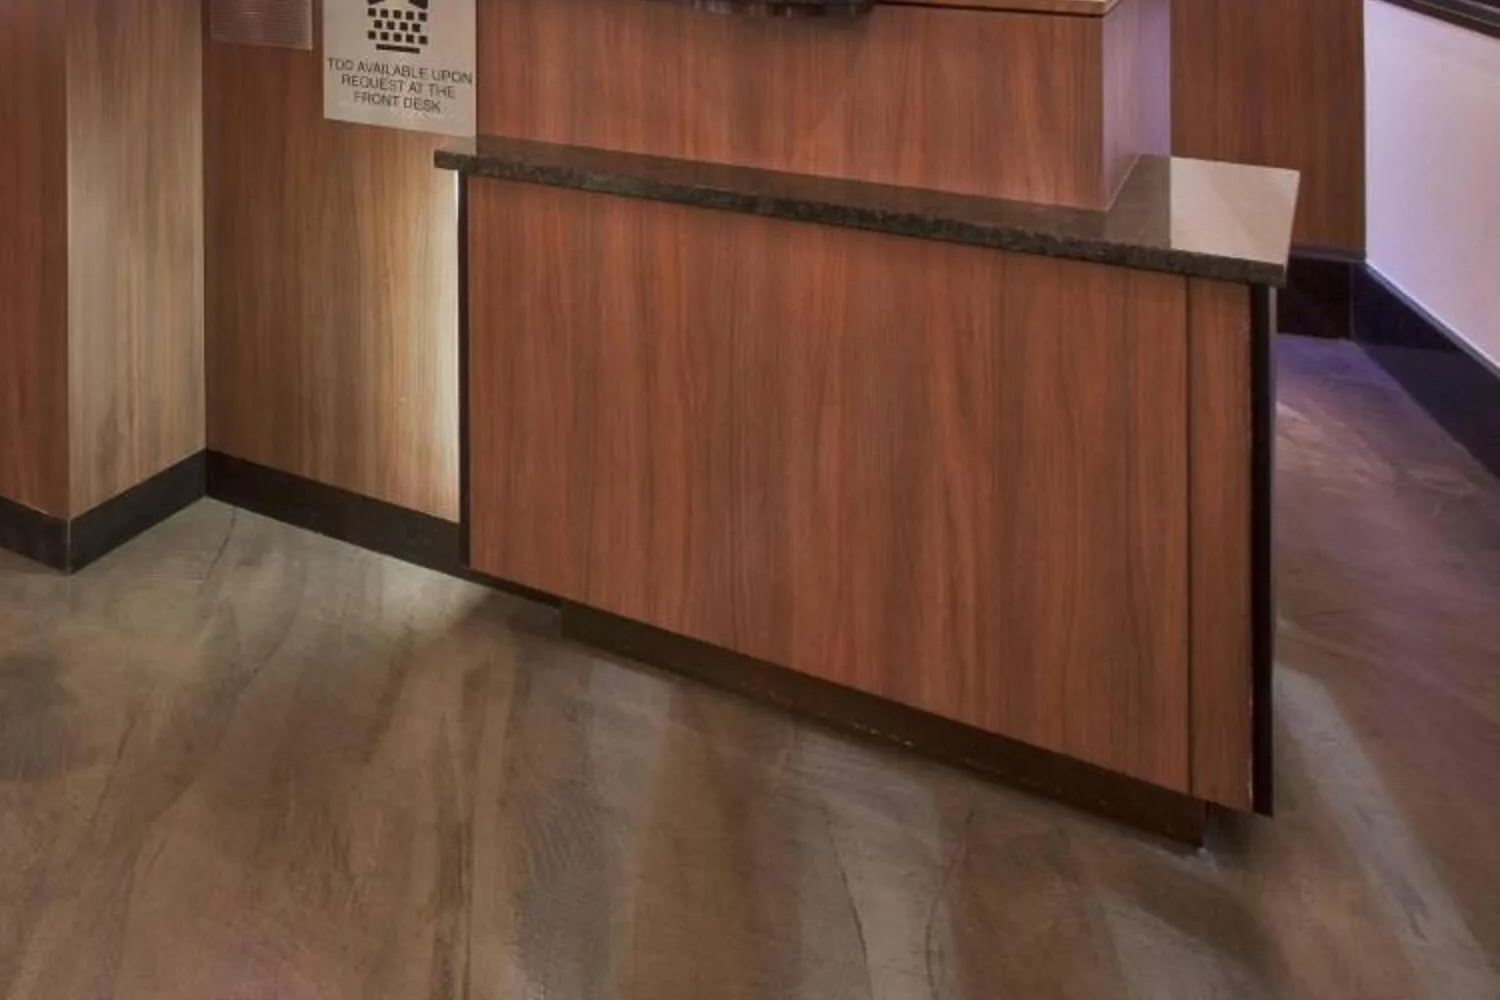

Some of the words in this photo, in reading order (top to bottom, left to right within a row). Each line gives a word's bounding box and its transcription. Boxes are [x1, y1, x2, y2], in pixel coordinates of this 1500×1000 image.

[357, 61, 429, 80] AVAILABLE
[431, 69, 473, 85] UPON
[341, 73, 404, 92] REQUEST
[408, 81, 423, 93] AT
[429, 84, 456, 99] THE
[353, 91, 399, 107] FRONT
[403, 98, 441, 113] DESK
